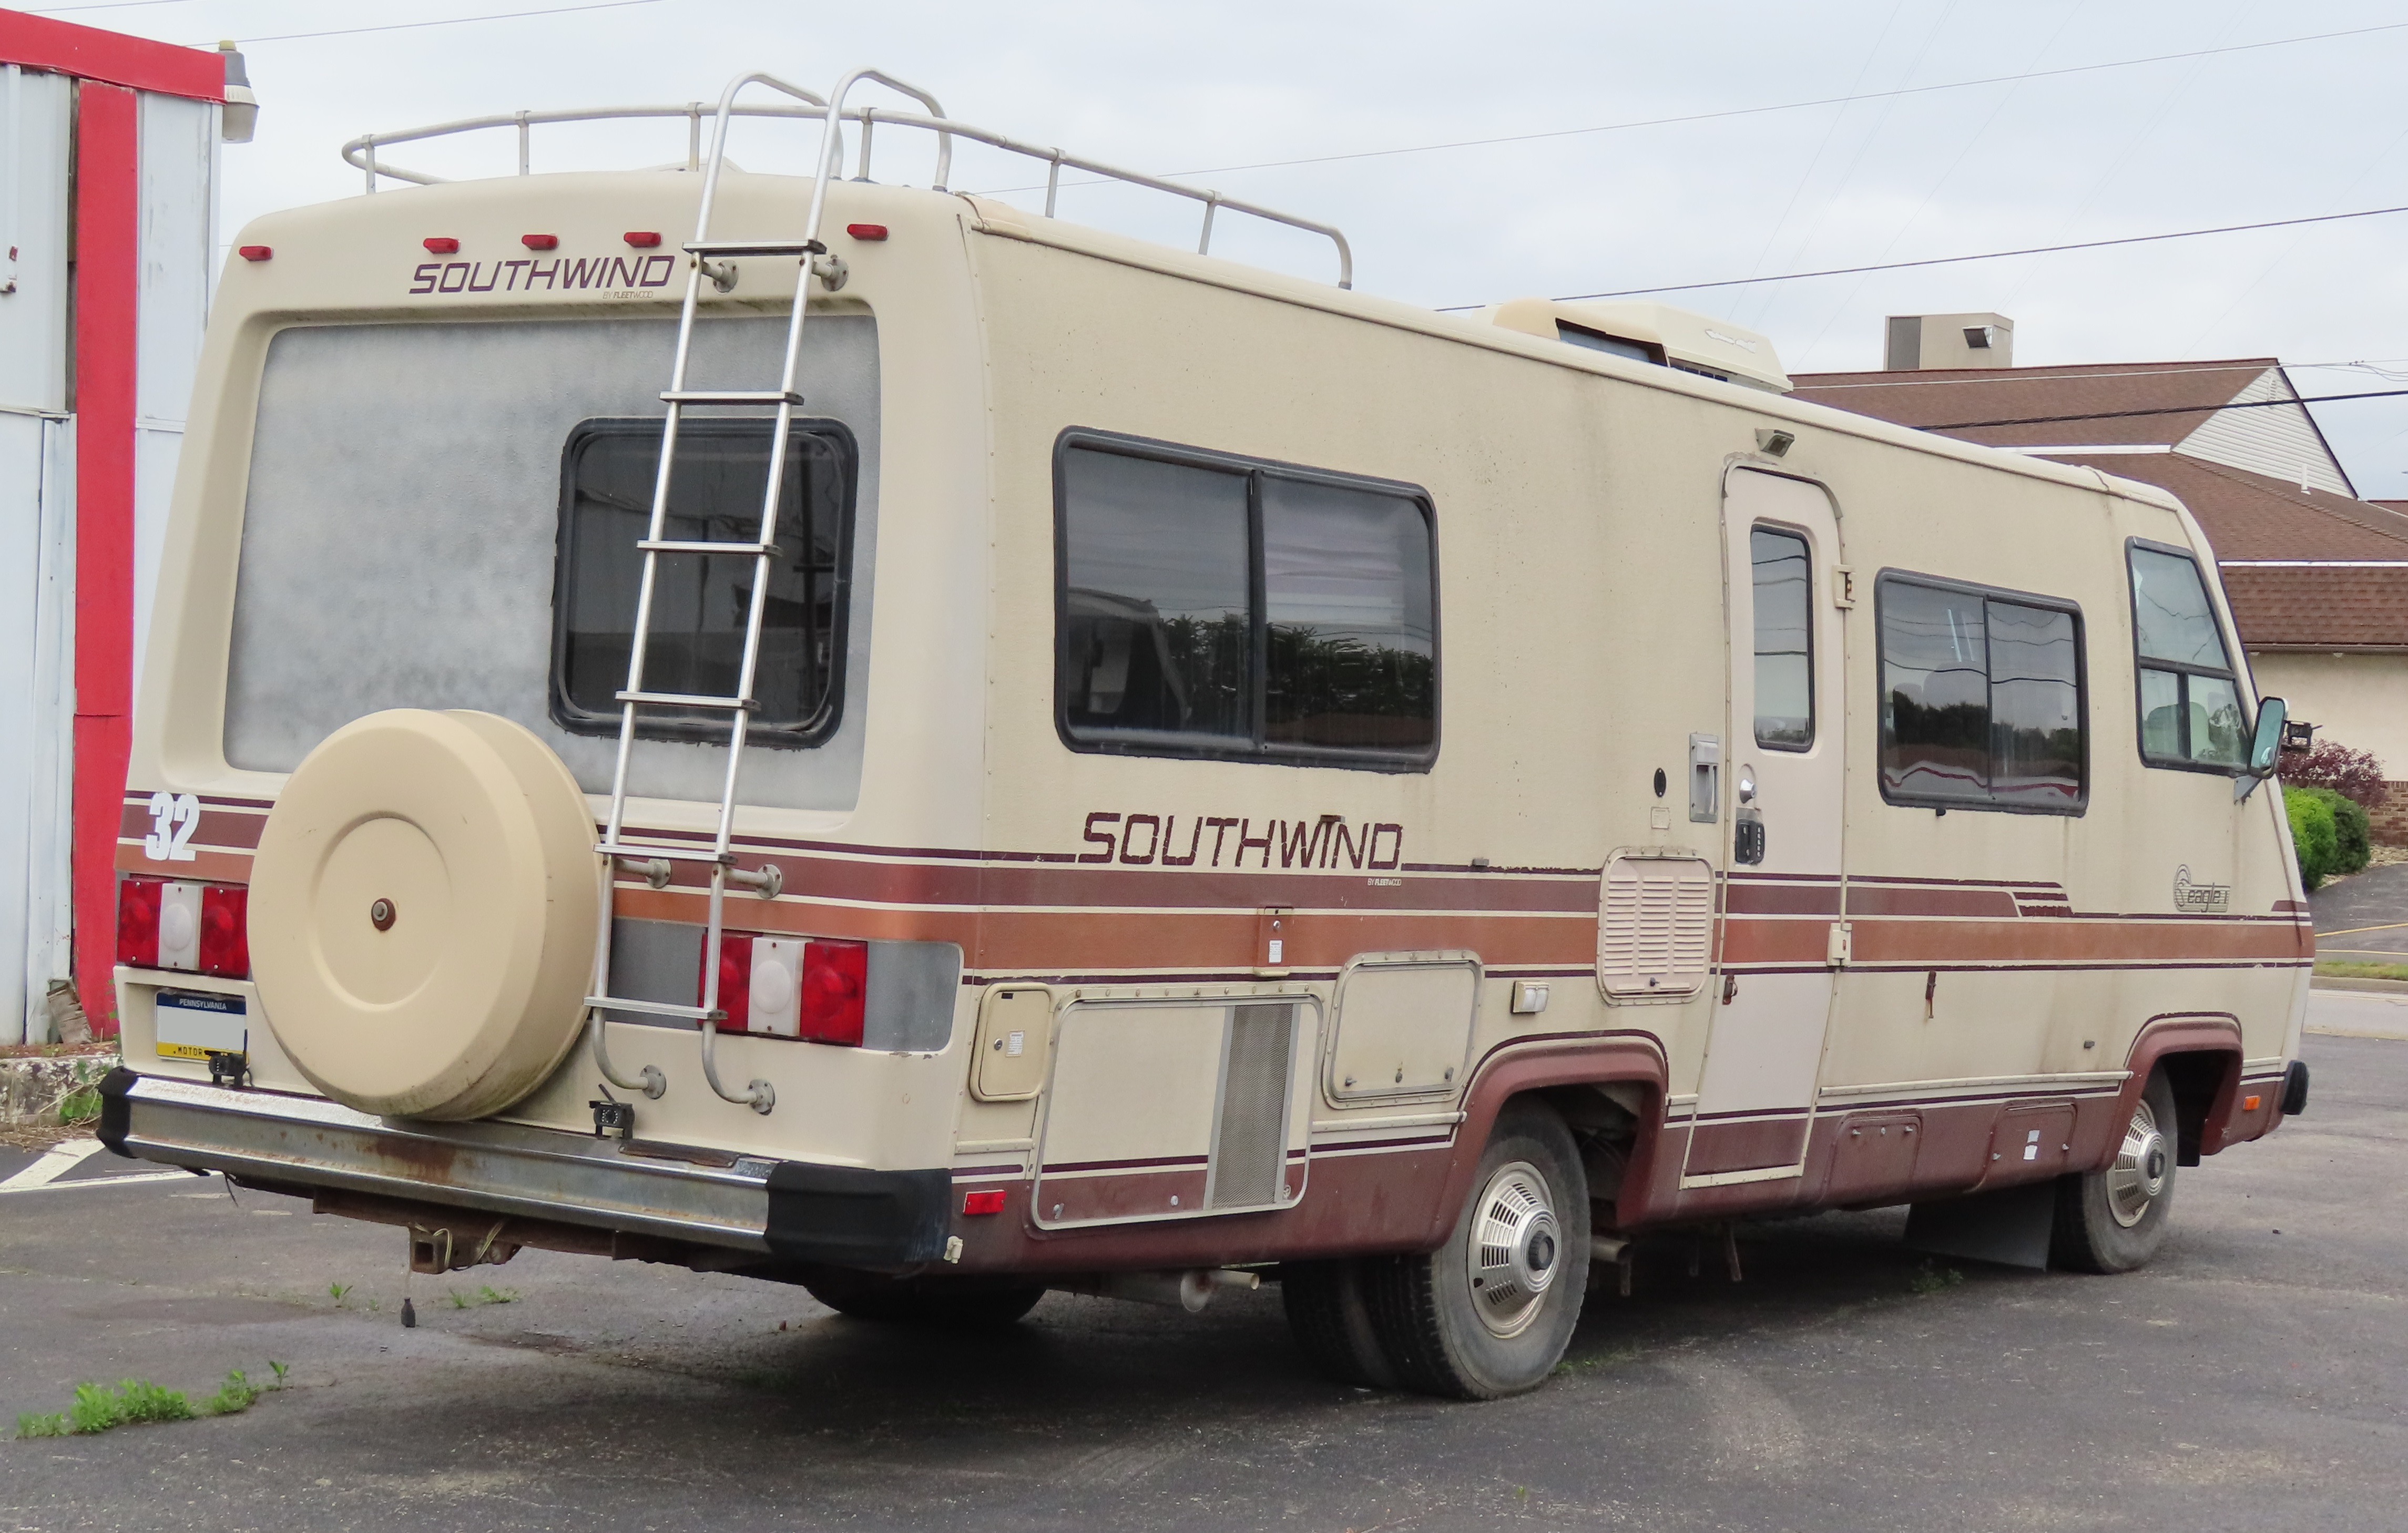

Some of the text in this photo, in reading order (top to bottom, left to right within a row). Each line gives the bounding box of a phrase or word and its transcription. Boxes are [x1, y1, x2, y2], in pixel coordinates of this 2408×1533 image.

[409, 255, 675, 294] SOUTHWIND
[146, 790, 200, 861] 32
[1078, 812, 1403, 870] SOUTHWIND
[1374, 878, 1402, 886] FLEETWOOD
[2188, 882, 2221, 913] eagle
[179, 998, 227, 1010] PENNSYLVANIA
[178, 1046, 203, 1056] MOTOR
